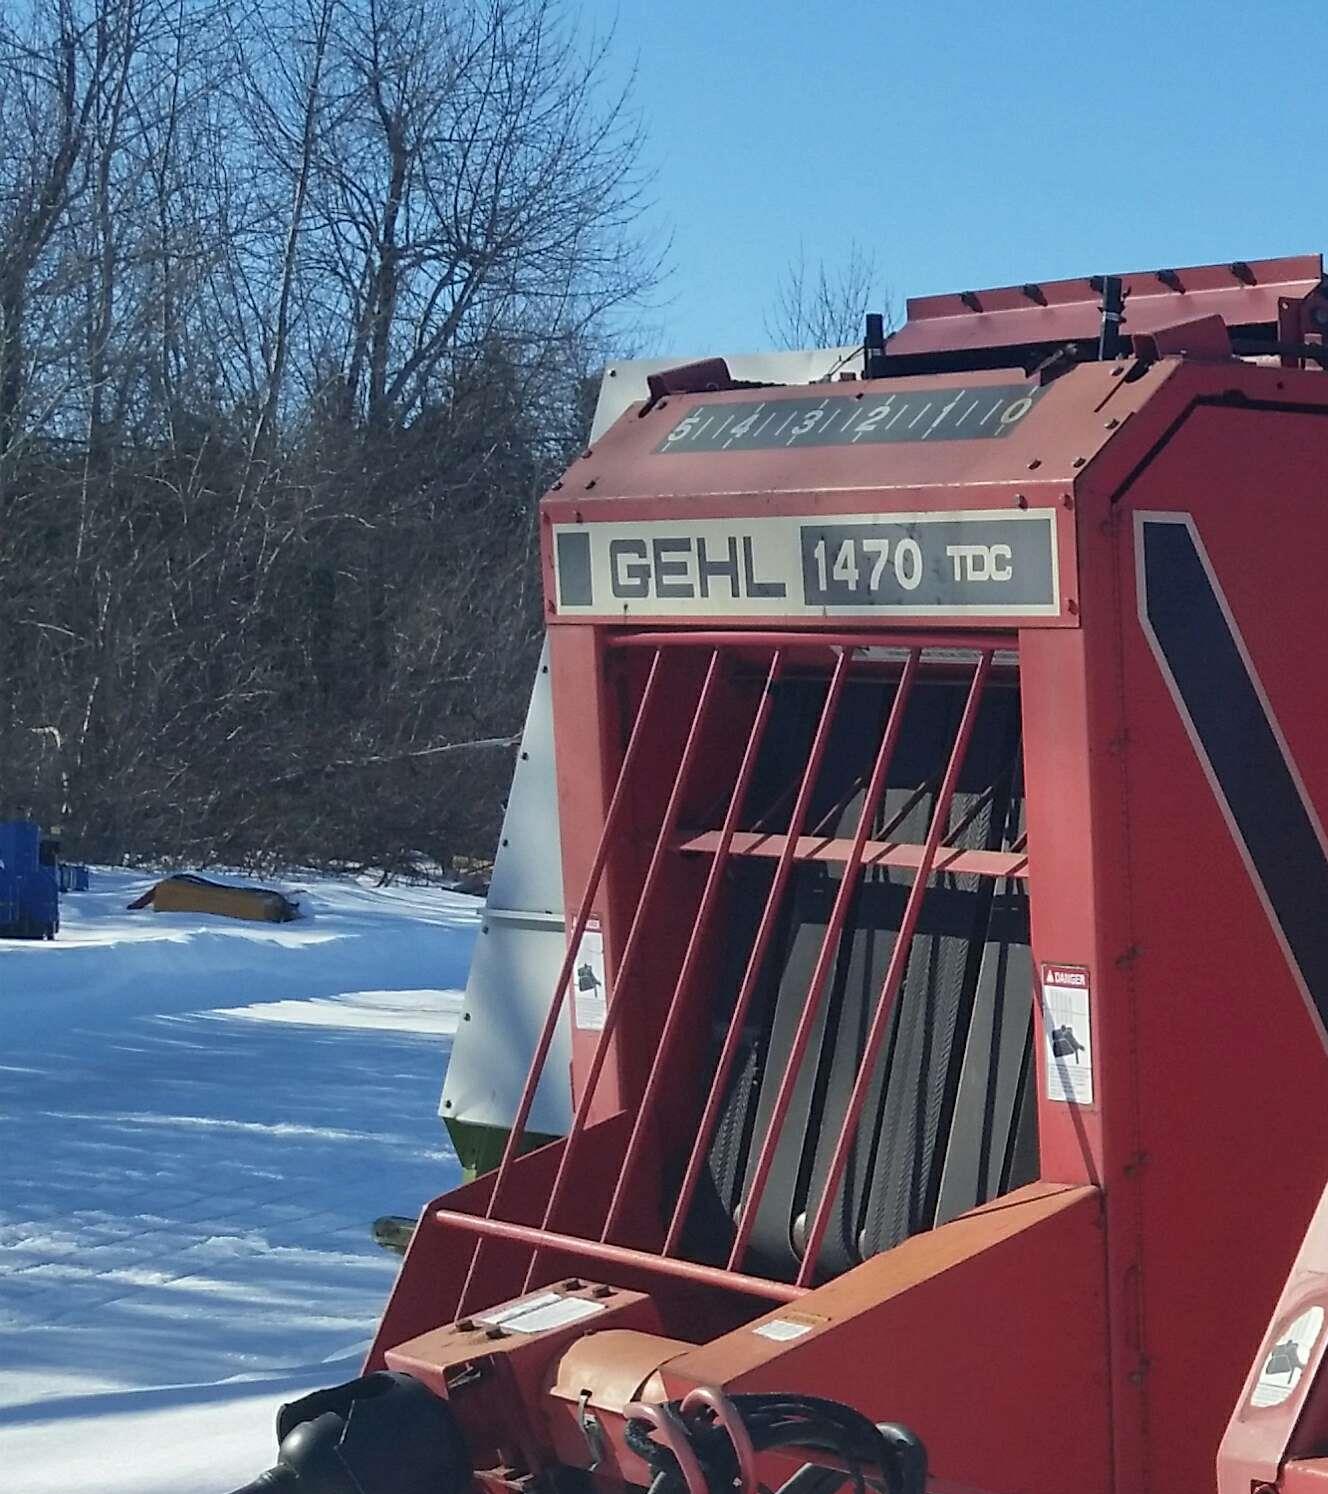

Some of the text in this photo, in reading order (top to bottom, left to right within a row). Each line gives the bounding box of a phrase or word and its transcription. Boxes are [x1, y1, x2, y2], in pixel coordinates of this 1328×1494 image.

[668, 417, 701, 441] 5
[791, 410, 825, 435] 3
[854, 406, 890, 432] 2
[1001, 398, 1033, 424] 0
[608, 535, 1013, 600] GEHL 1470 TDC
